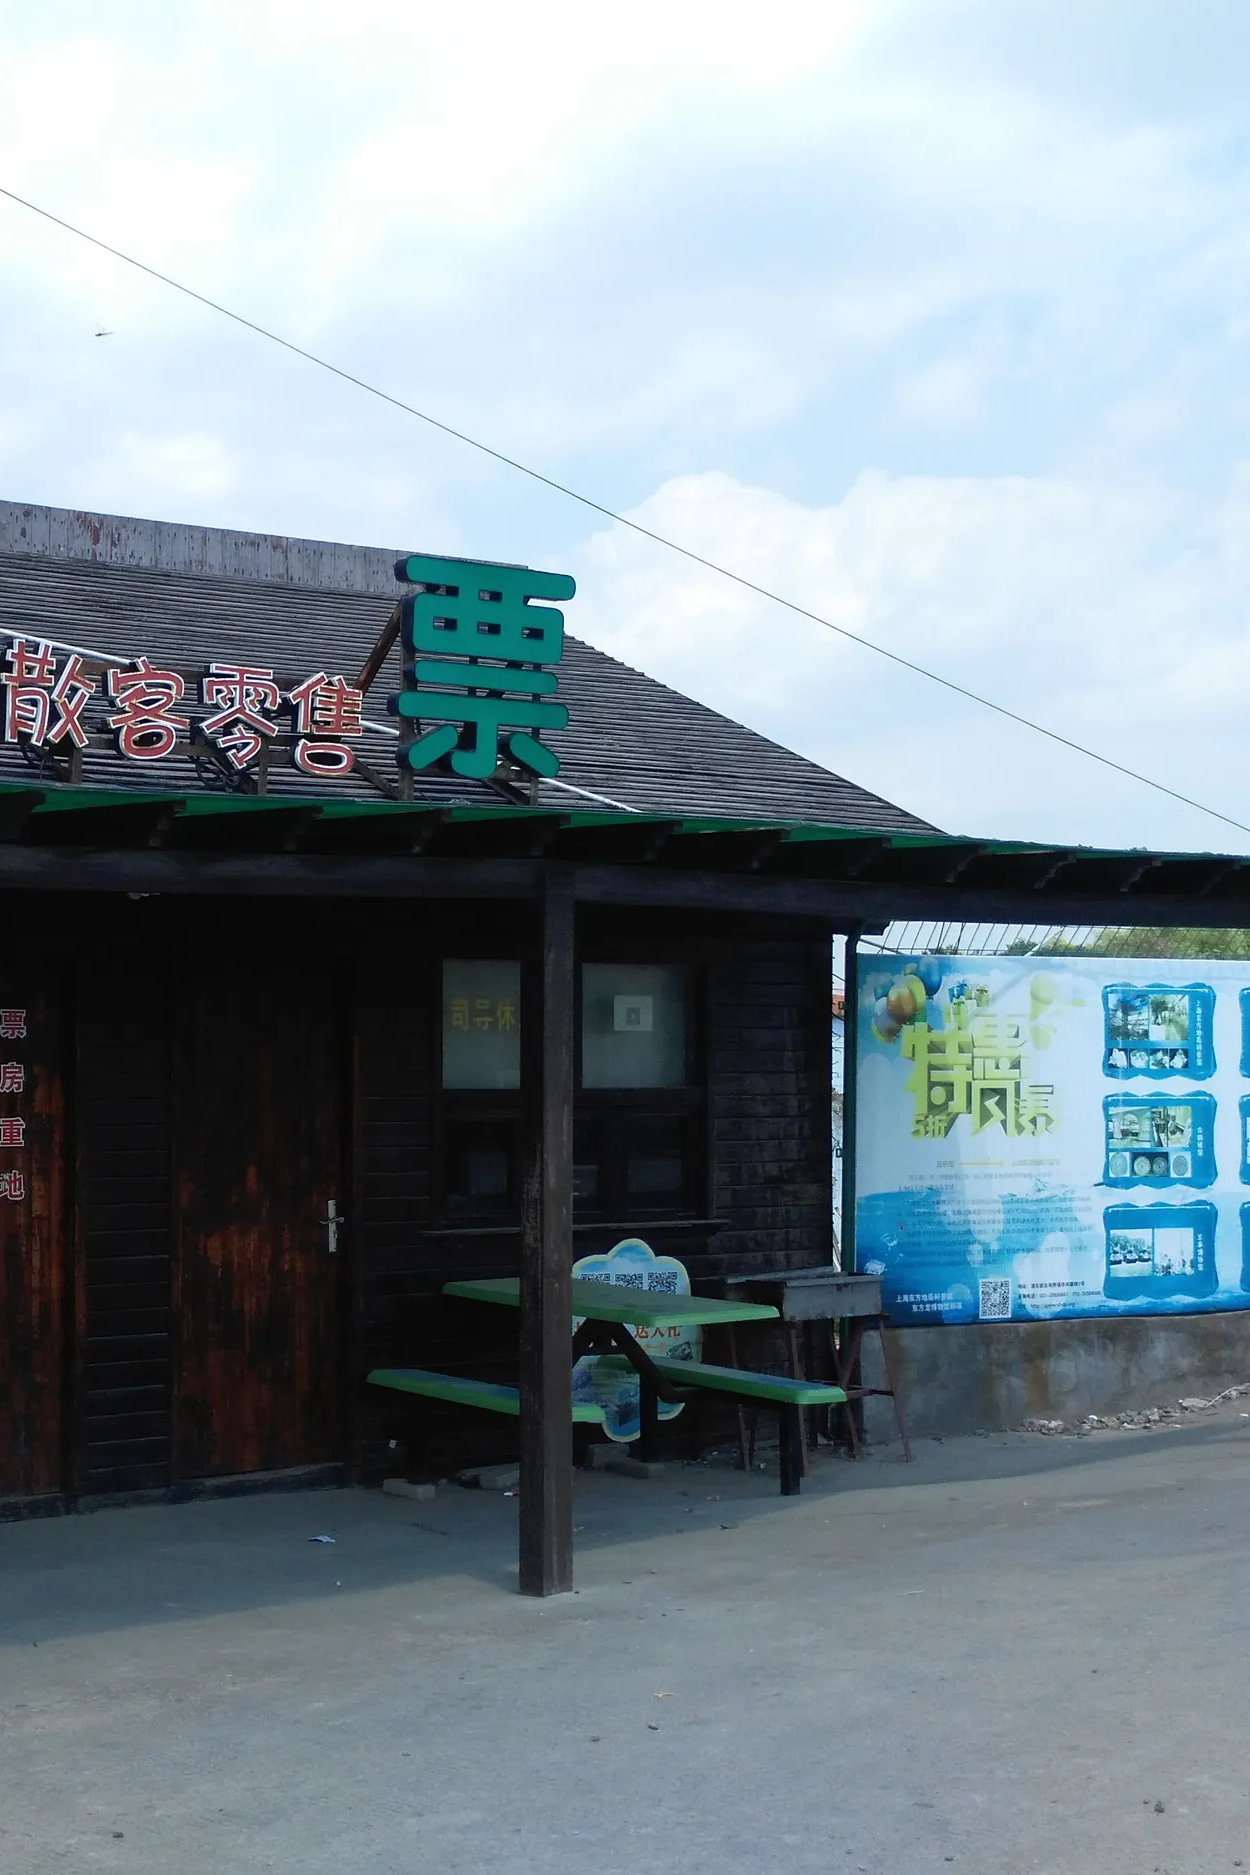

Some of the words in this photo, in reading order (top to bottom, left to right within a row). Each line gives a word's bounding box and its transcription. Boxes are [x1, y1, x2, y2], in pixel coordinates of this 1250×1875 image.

[1, 638, 364, 777] 散客零售
[393, 555, 577, 780] 票
[911, 1114, 948, 1139] 5折
